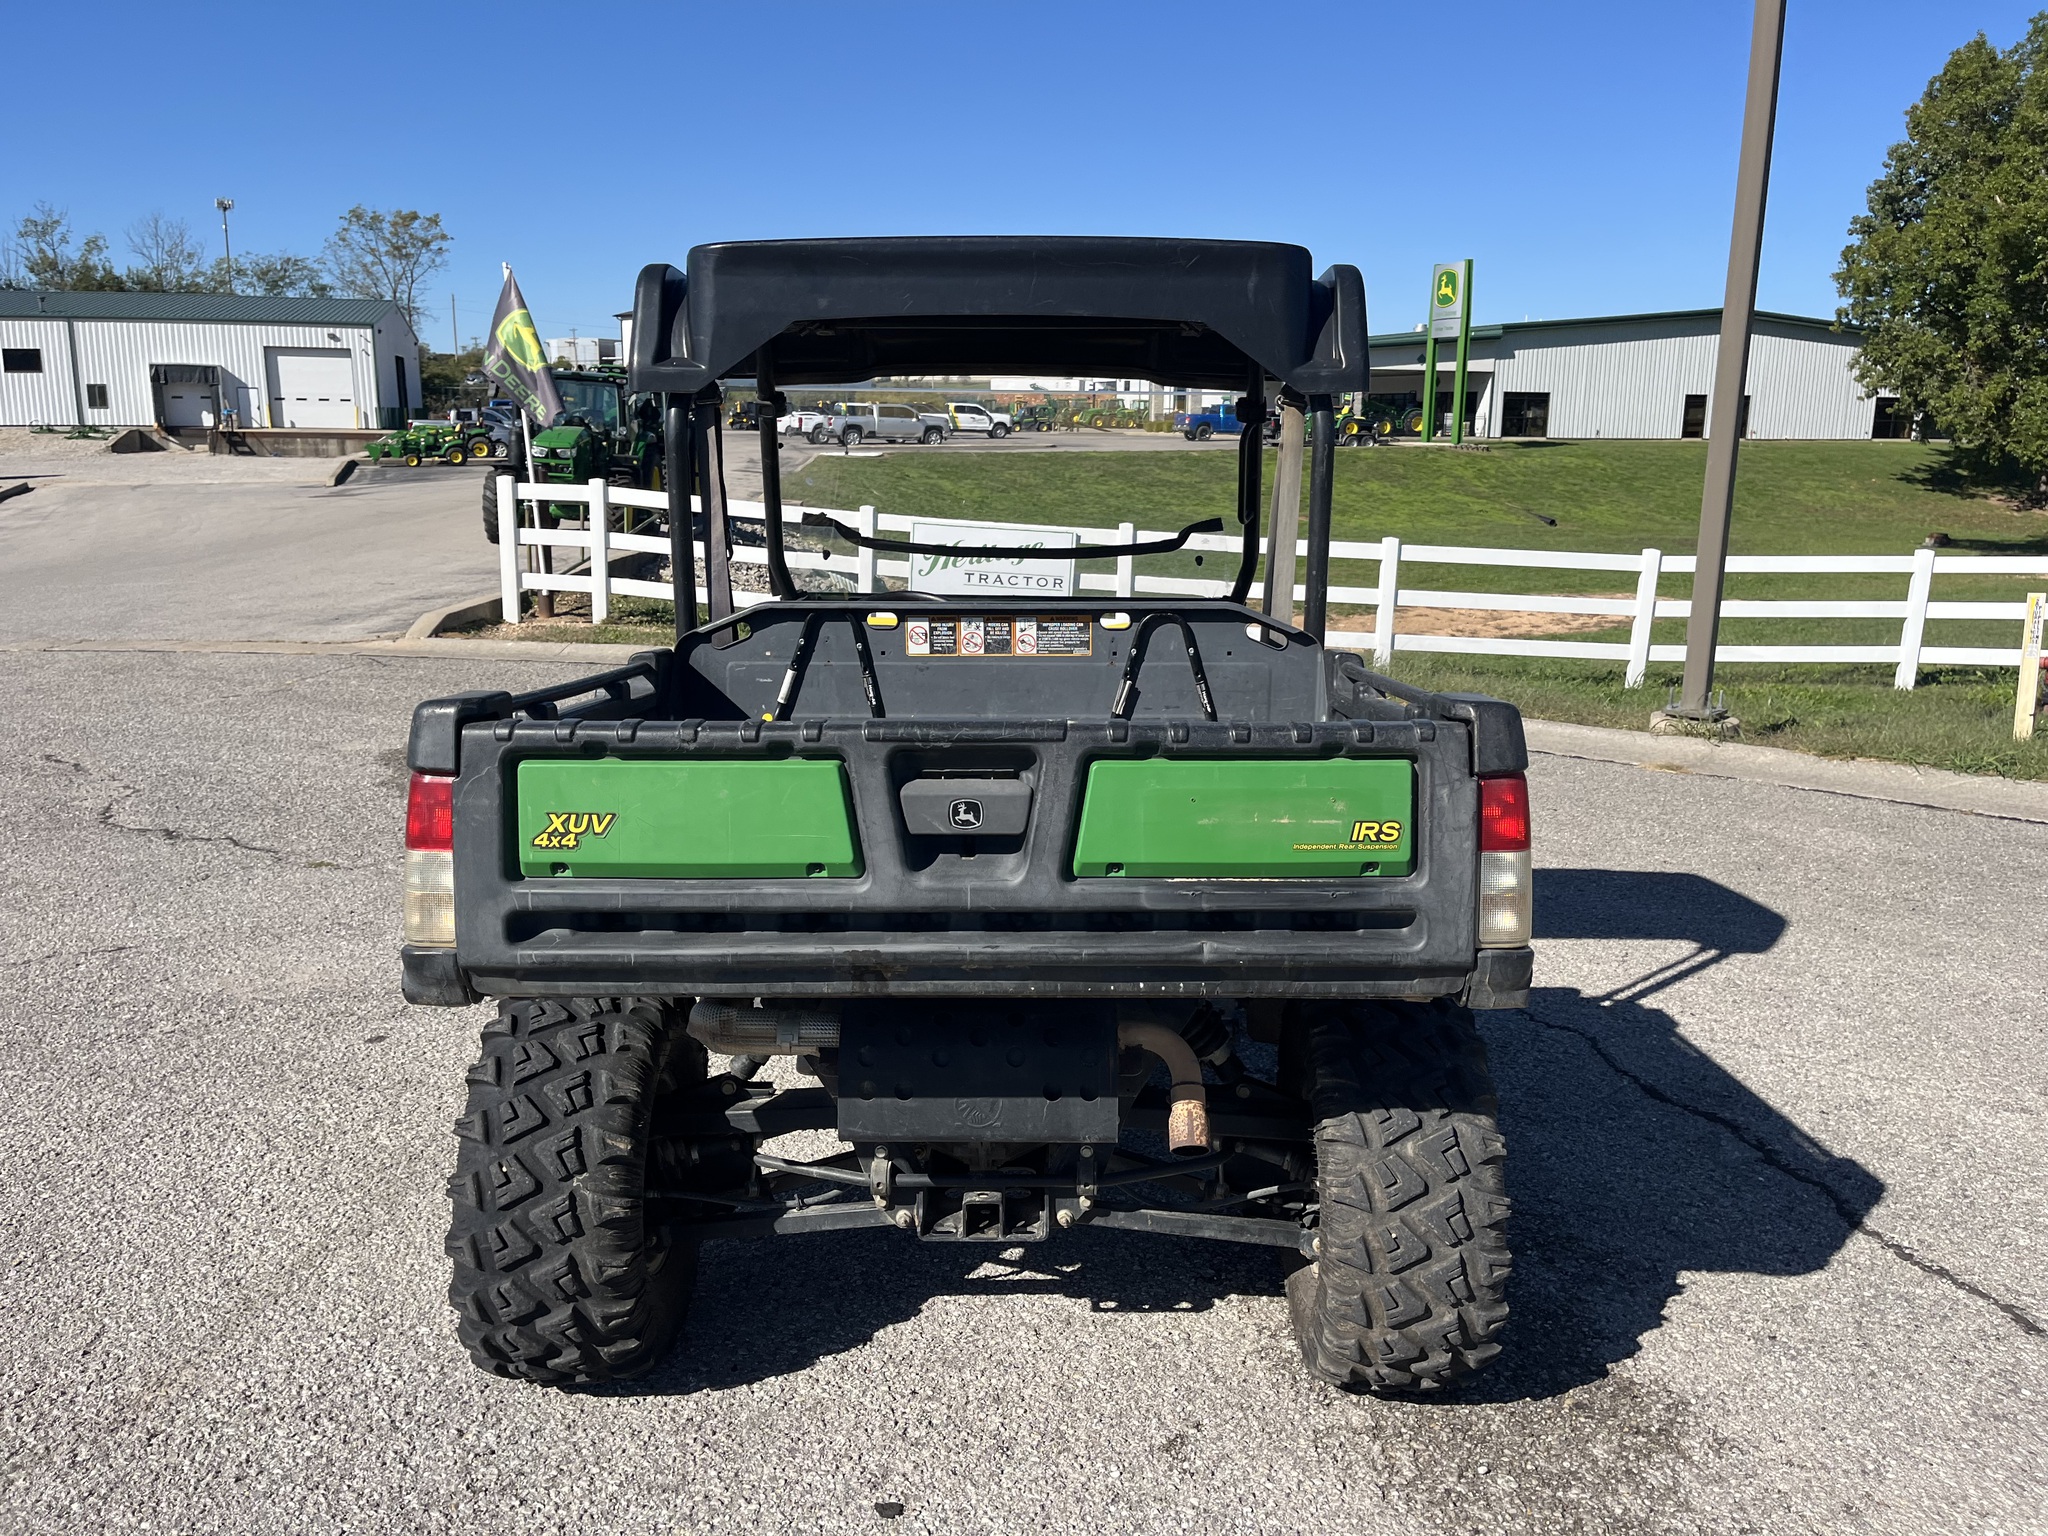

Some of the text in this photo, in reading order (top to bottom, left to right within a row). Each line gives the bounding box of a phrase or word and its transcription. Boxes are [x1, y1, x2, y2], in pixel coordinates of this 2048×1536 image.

[490, 359, 547, 421] DEERE
[964, 572, 1064, 589] TRACTOR
[544, 812, 616, 835] XUV
[1350, 821, 1402, 842] IRS
[532, 832, 578, 849] 4x4
[1293, 843, 1398, 852] Independent Rear Suspension
